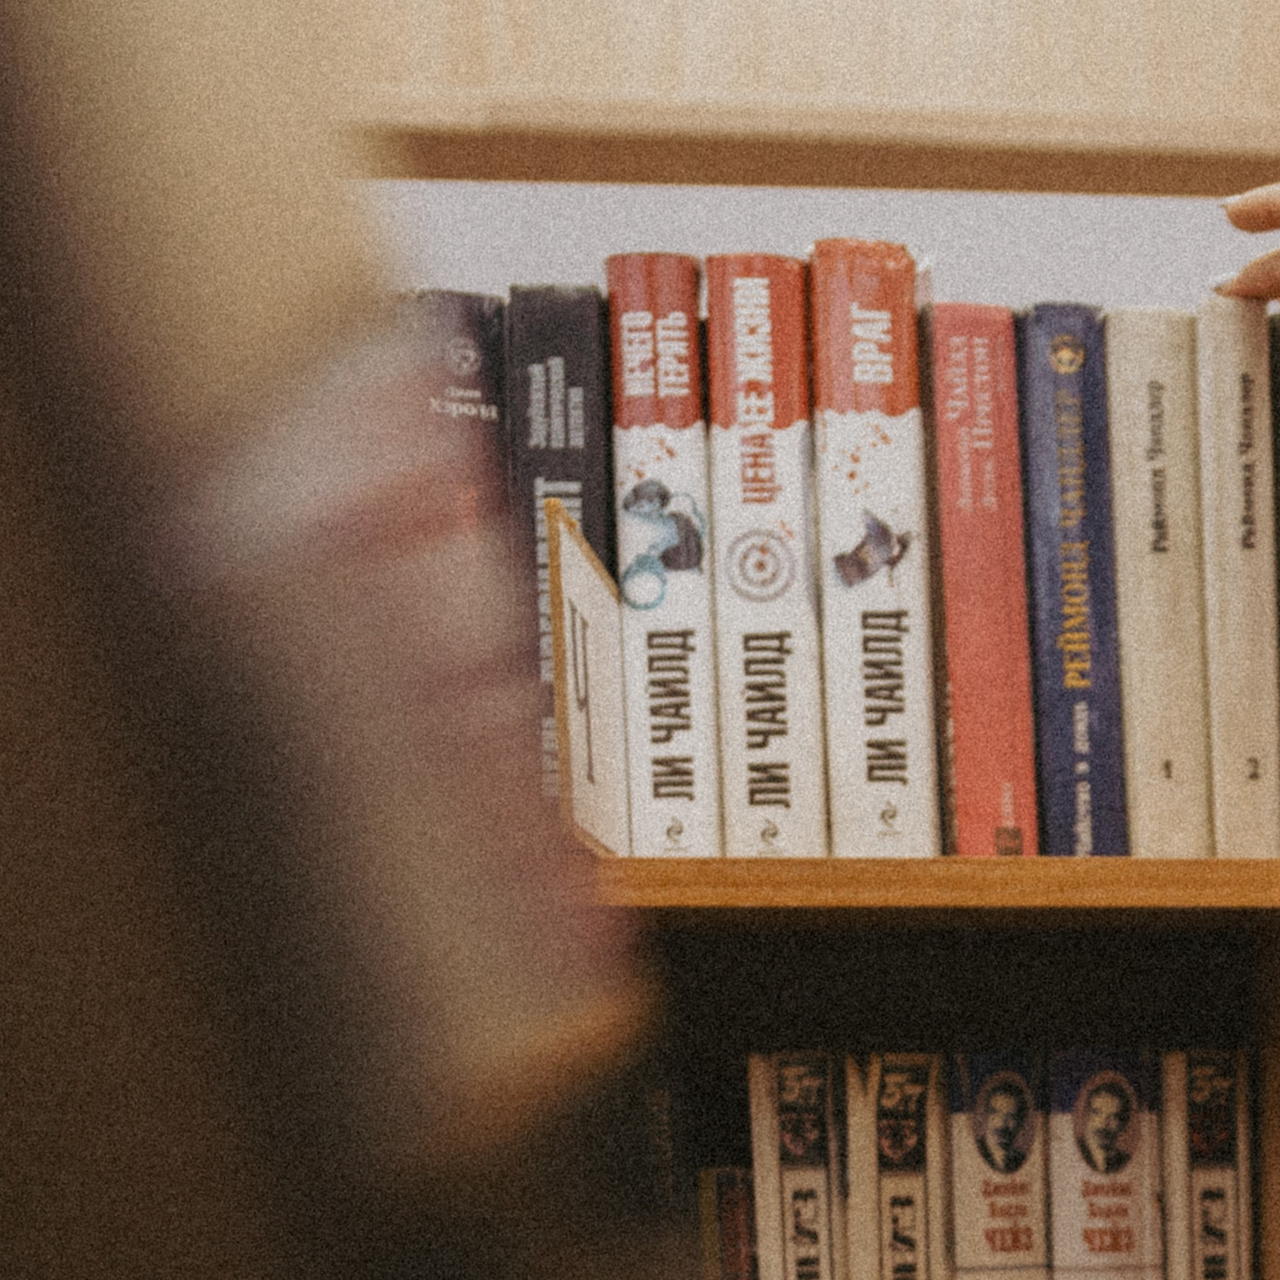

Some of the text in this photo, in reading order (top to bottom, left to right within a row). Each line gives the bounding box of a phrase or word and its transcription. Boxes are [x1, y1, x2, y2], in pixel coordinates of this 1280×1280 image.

[621, 311, 654, 397] НЕЧЕГО
[657, 311, 692, 398] ТЕРЯТЬ
[734, 276, 782, 506] ЦЕНА ЕЕ ЖИЗНИ
[851, 302, 894, 384] ВРАГ
[1057, 540, 1091, 689] РЕЙМОНД
[644, 627, 695, 802] ЛИ ЧАЙЛД
[742, 630, 792, 810] ЛИ ЧАЙЛД
[861, 610, 908, 785] ЛИ ЧАЙЛД
